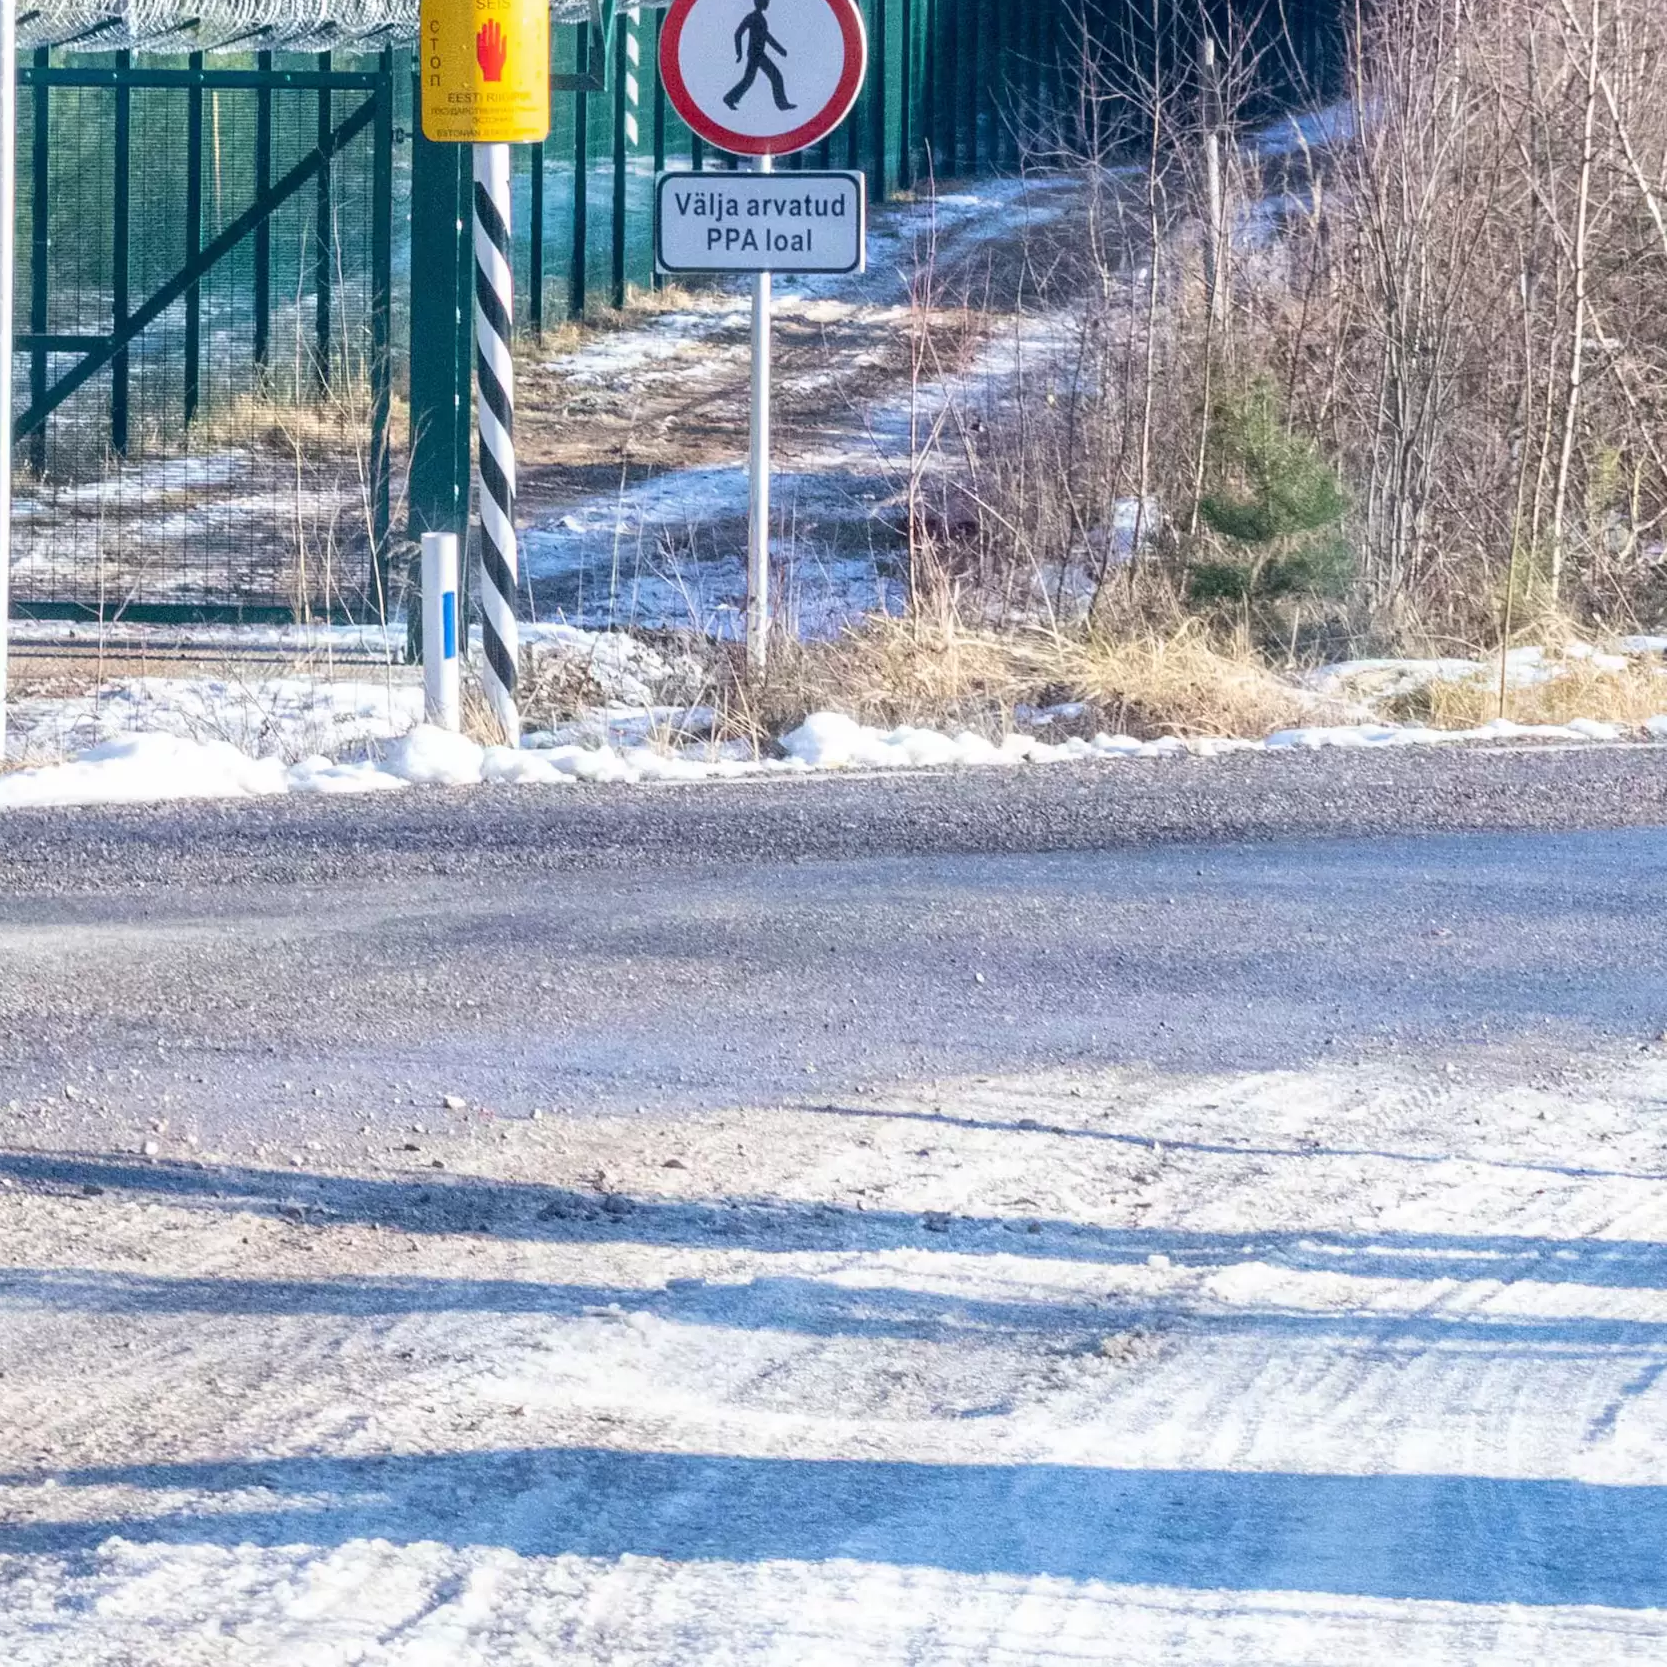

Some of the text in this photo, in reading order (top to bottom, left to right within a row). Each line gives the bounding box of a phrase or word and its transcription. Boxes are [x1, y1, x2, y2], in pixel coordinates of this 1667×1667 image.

[674, 192, 846, 222] Välja arvatud
[706, 228, 812, 252] PPA loal
